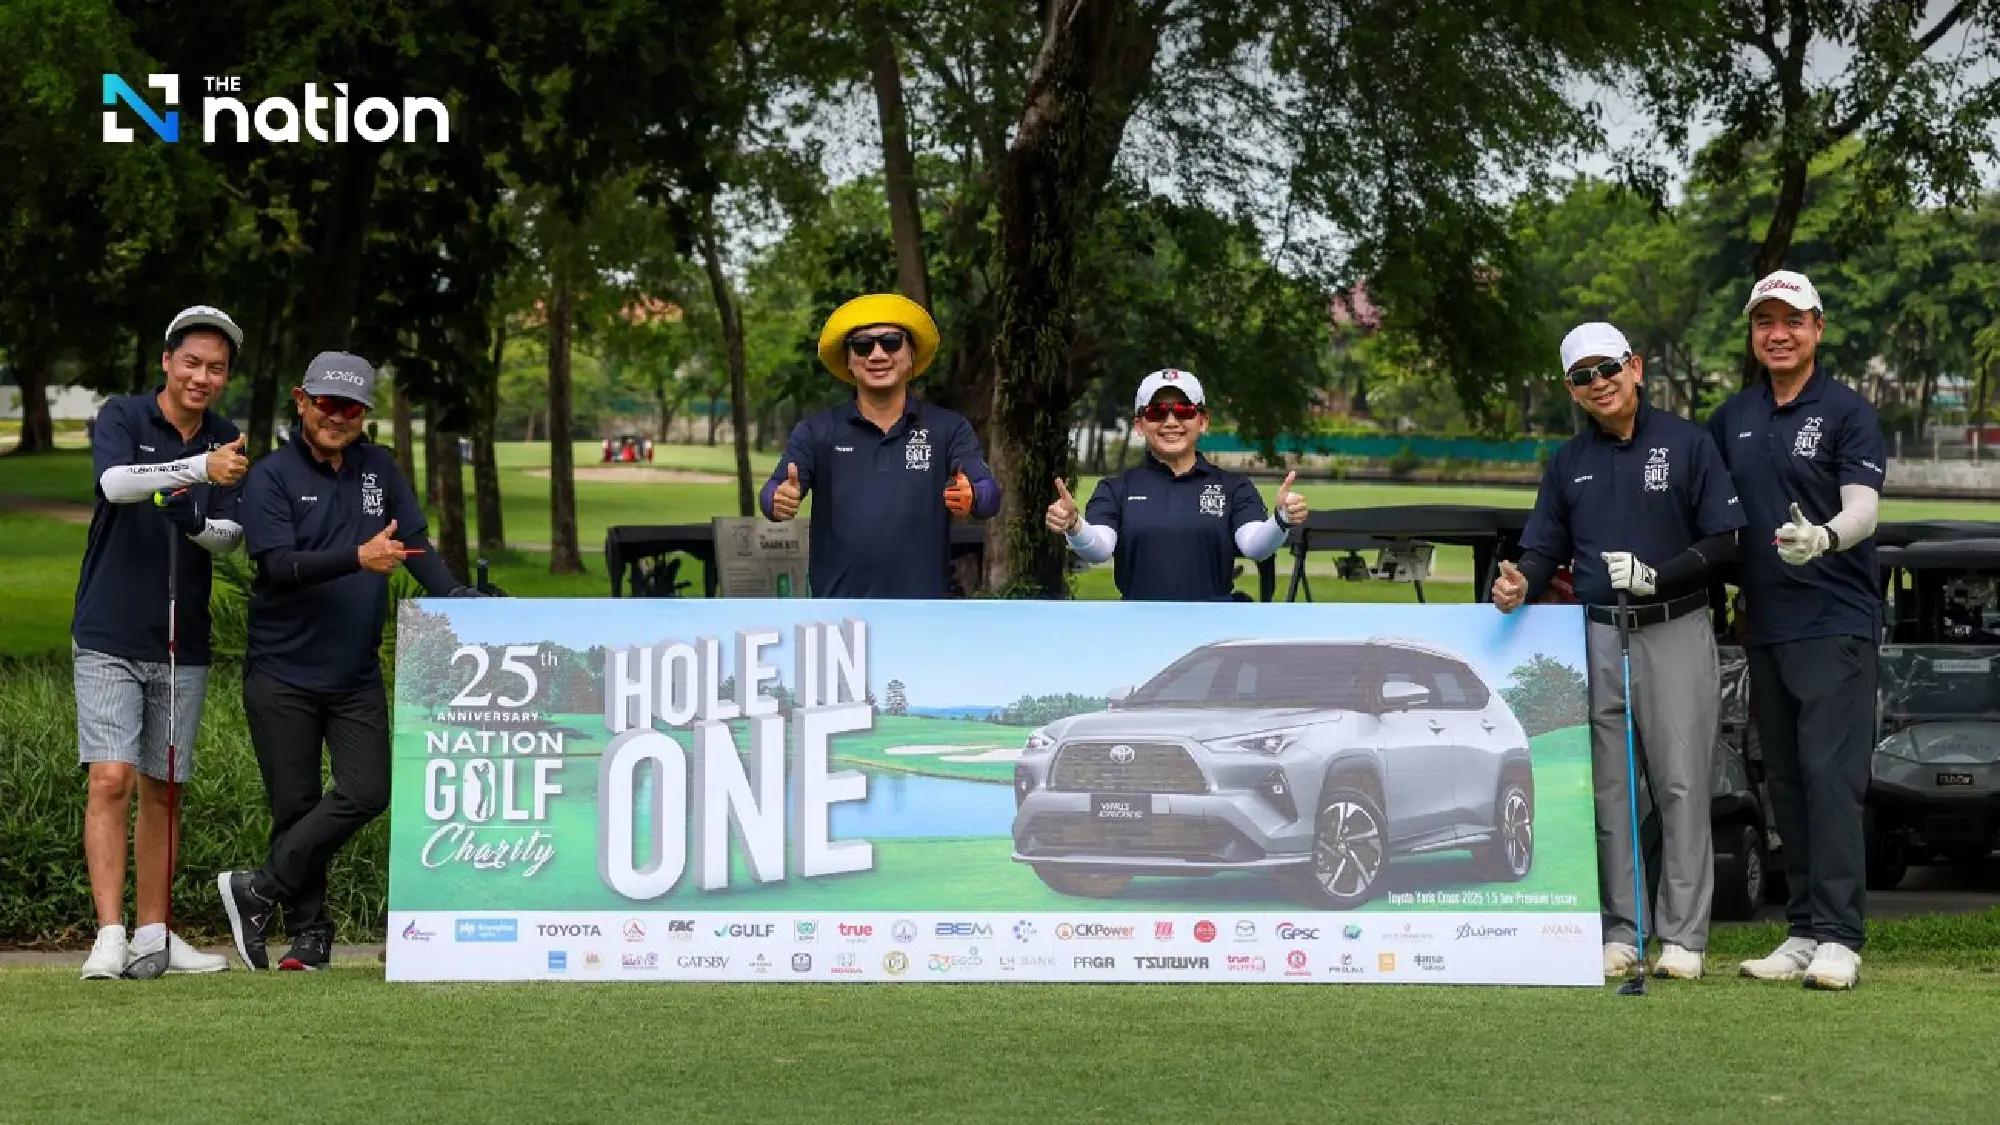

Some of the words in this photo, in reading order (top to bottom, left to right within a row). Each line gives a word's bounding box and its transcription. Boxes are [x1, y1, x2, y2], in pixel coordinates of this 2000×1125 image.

[909, 429, 929, 441] 25
[905, 449, 932, 461] GOLF
[1648, 447, 1670, 461] 25
[1644, 469, 1670, 482] GOLF
[604, 629, 780, 733] HOLE
[794, 617, 867, 709] IN
[436, 711, 540, 721] ANNIVERSARY
[424, 731, 564, 754] NATION
[424, 758, 564, 823] GOLF
[599, 702, 874, 901] ONE
[421, 821, 556, 878] Charity
[1387, 890, 1414, 906] Toyota
[536, 924, 602, 937] TOYOTA
[728, 924, 775, 938] GULF
[837, 922, 873, 937] true
[1075, 923, 1135, 938] CKPower
[1281, 927, 1320, 940] GPSC
[676, 955, 730, 971] GATSBY
